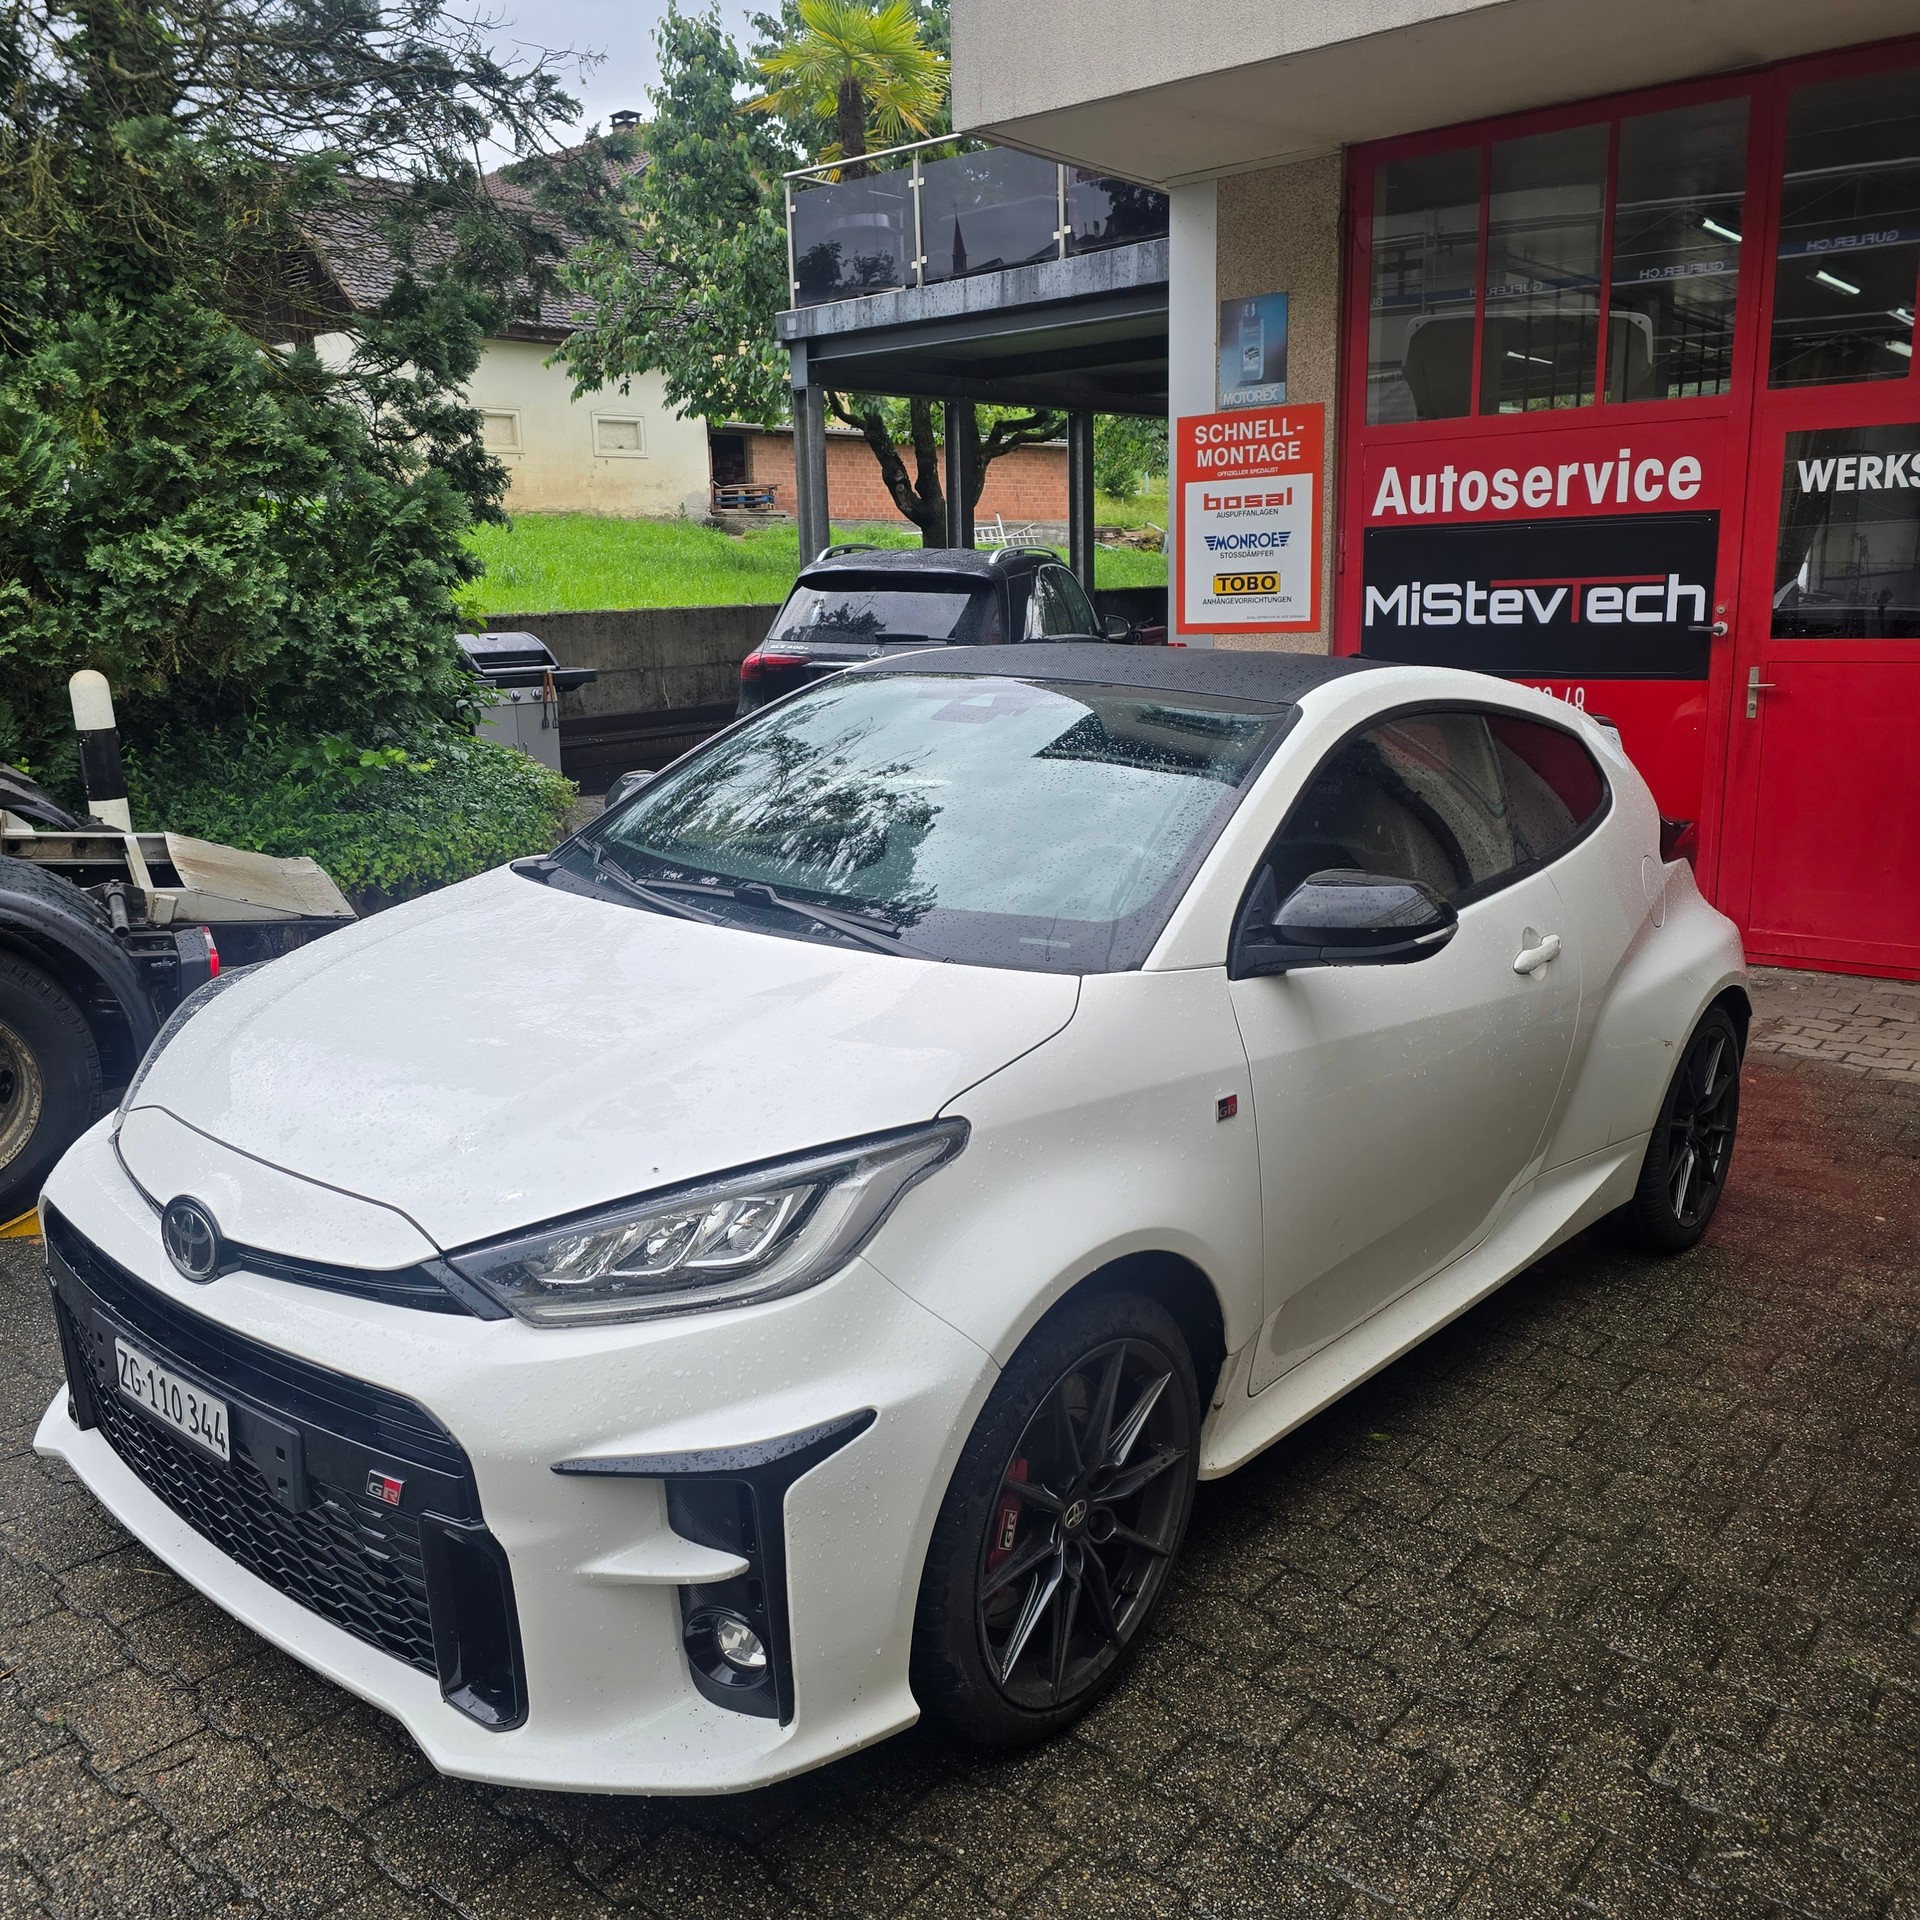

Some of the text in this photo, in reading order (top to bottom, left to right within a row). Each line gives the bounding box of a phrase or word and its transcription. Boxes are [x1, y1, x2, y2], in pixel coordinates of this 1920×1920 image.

[1223, 388, 1280, 406] MOTOREX
[1195, 418, 1305, 445] SCHNELL-
[1197, 441, 1301, 468] MONTAGE
[1217, 466, 1279, 477] OFFIZIELLER SPEZIALIST
[1371, 448, 1702, 517] Autoservice
[1203, 487, 1293, 511] bosal
[1216, 508, 1279, 519] AUSPUFFANLAGEN
[1214, 531, 1280, 551] MONROE
[1219, 549, 1275, 559] STOSSDÄMPFER
[1217, 575, 1277, 592] TOBO
[1202, 595, 1292, 605] ANHÄNGEVORRICHTUNGEN
[187, 1393, 228, 1454] 344
[368, 1481, 400, 1504] GR
[1004, 1513, 1016, 1548] GR
